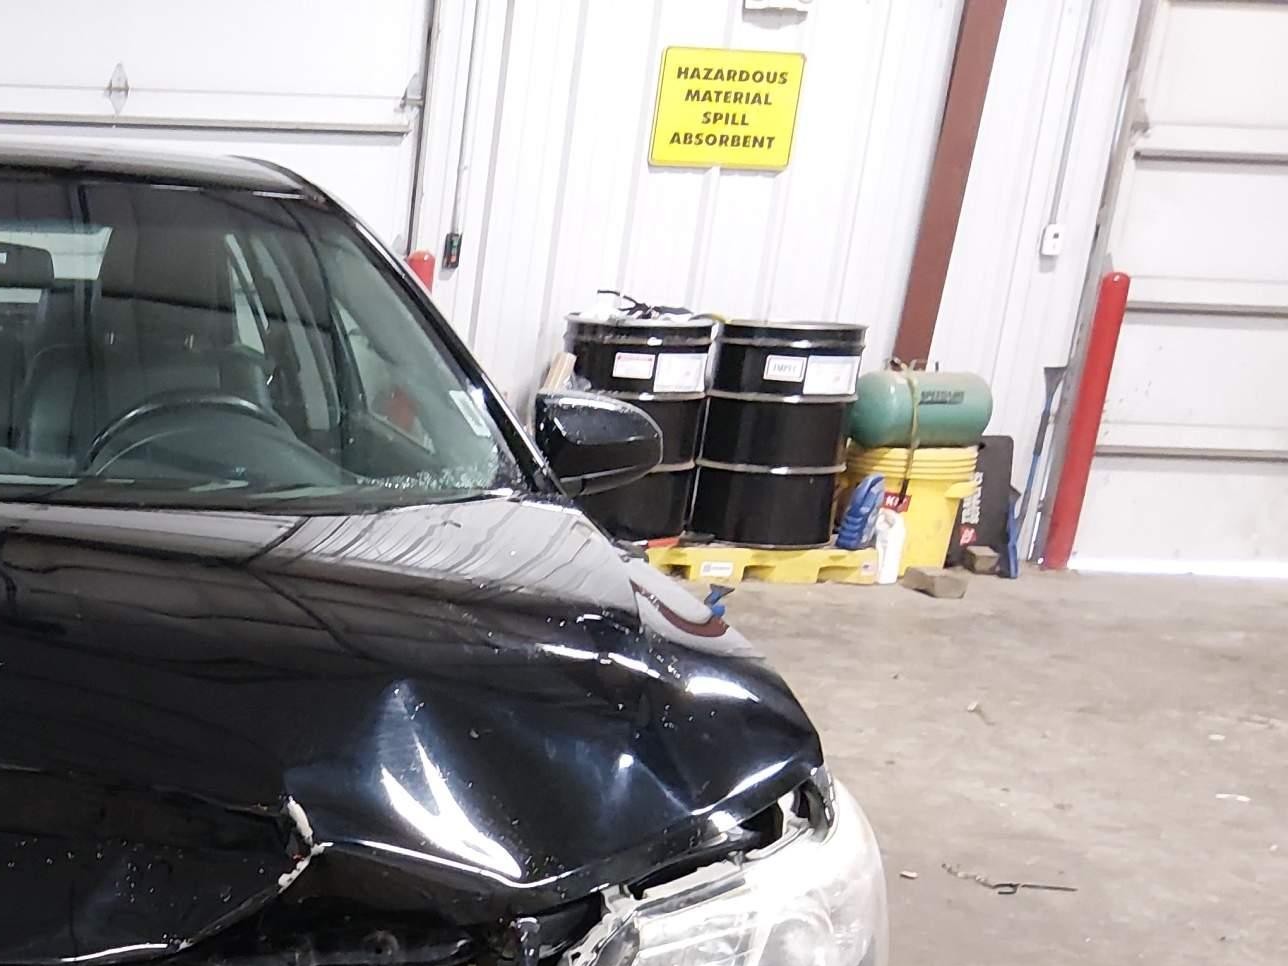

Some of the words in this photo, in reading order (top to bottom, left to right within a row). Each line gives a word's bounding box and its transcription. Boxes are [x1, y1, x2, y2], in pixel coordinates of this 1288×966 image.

[676, 66, 789, 85] HAZARDOUS
[684, 89, 772, 105] MATERIAL
[701, 111, 750, 126] SPILL
[669, 132, 776, 149] ABSORBENT
